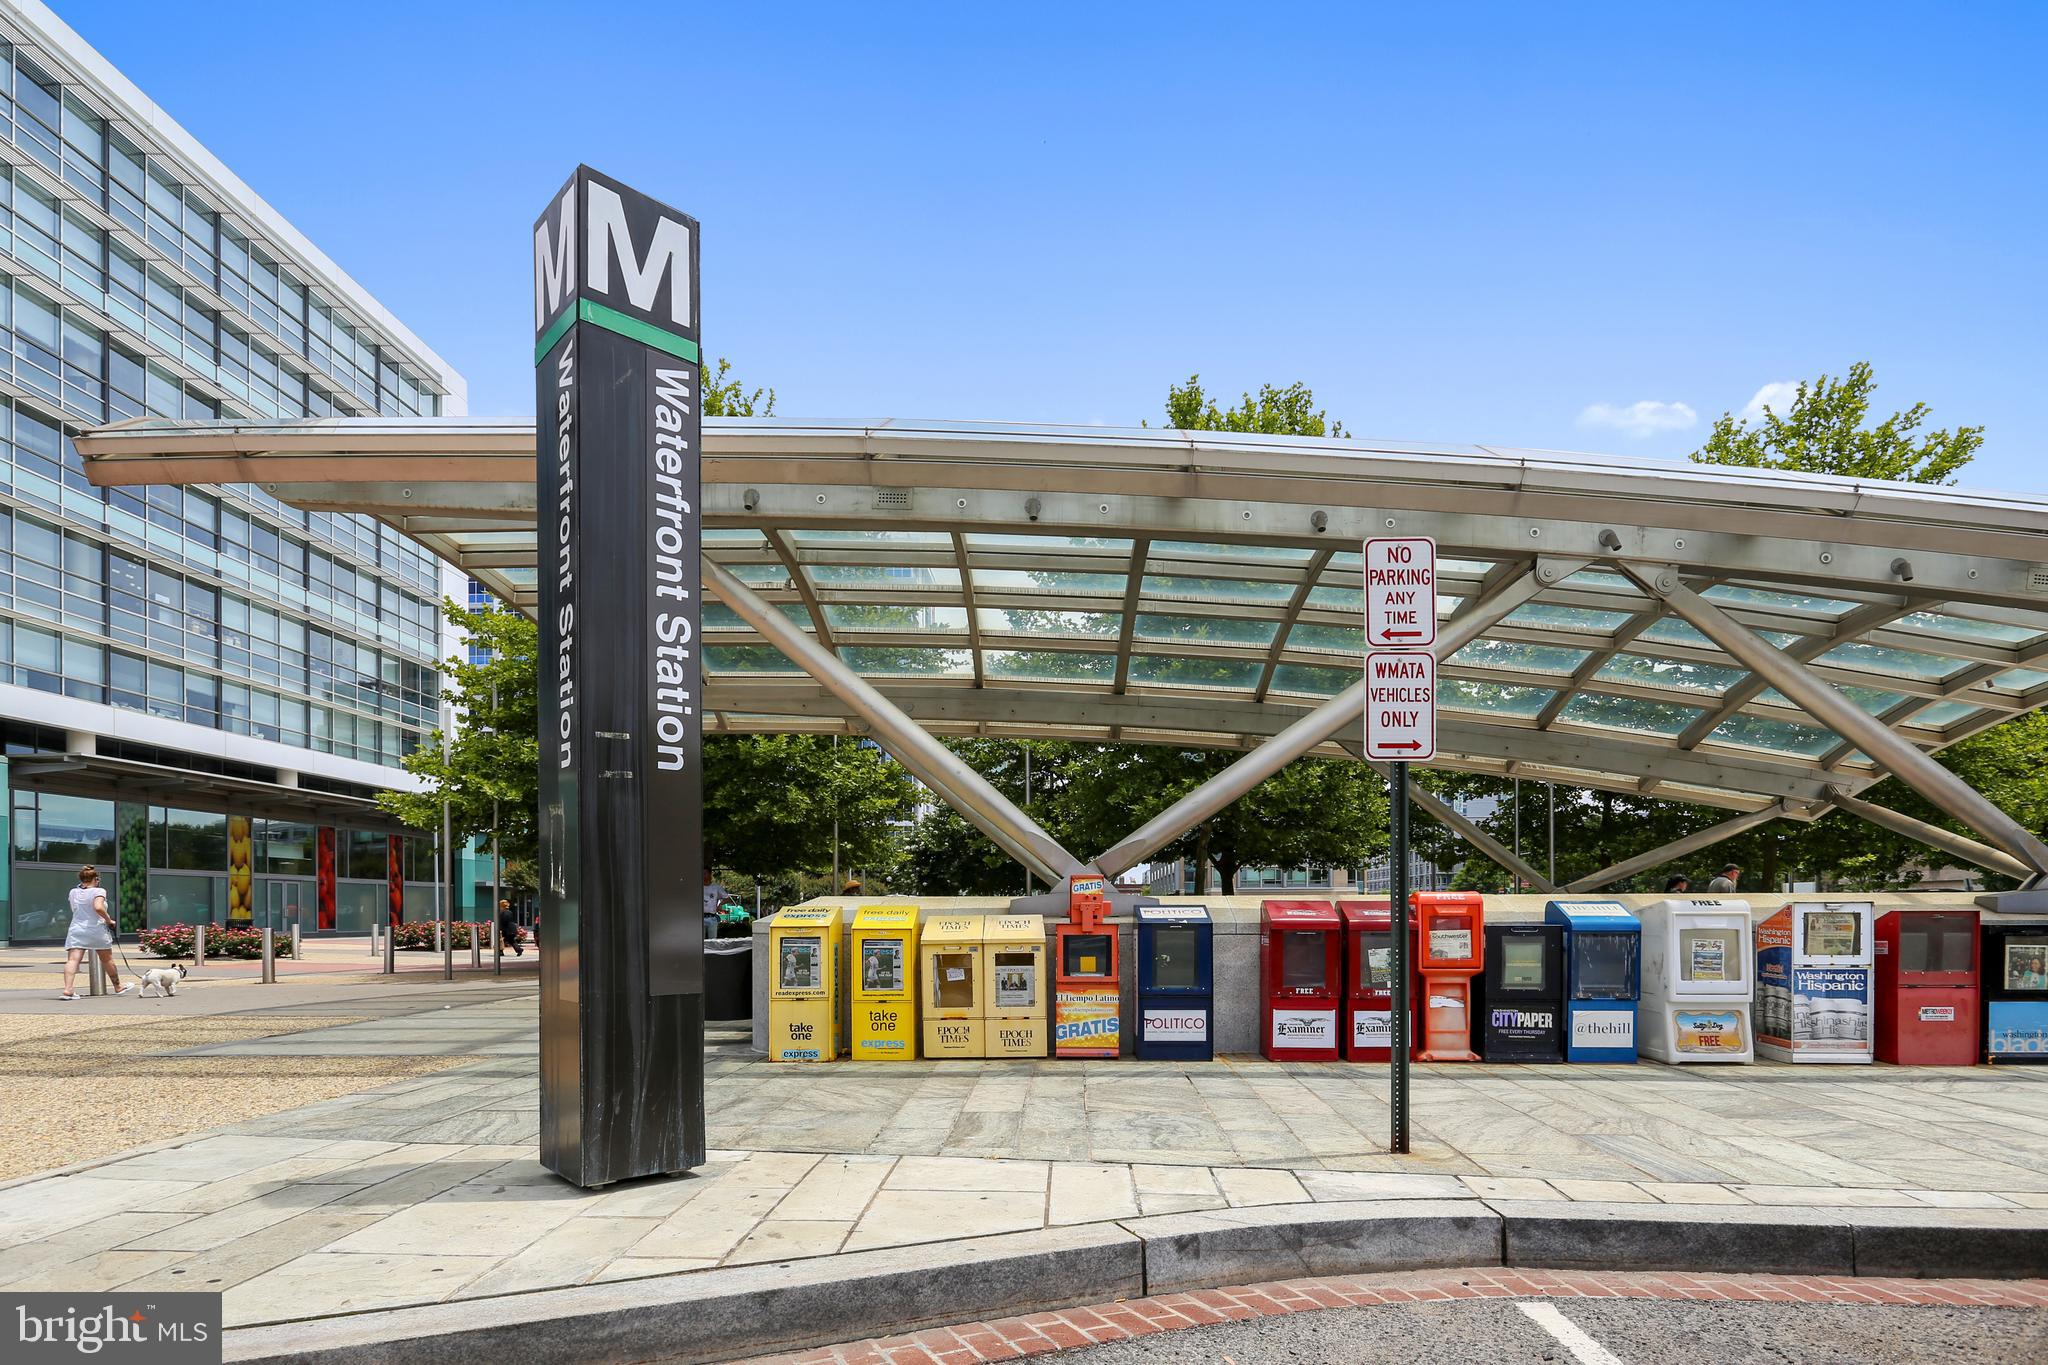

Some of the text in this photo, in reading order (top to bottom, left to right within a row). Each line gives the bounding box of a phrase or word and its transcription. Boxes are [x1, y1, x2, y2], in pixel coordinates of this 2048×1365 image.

[535, 184, 575, 332] M
[588, 179, 690, 328] M
[558, 338, 574, 769] Waterfront Station
[1387, 547, 1412, 564] NO
[655, 368, 692, 771] Waterfront Station
[1369, 569, 1431, 586] PARKING
[1385, 591, 1416, 605] ANY
[1384, 611, 1417, 624] TIME
[1375, 662, 1425, 679] WMATA
[1370, 687, 1431, 703] VEHICLES
[1381, 711, 1419, 728] ONLY
[1073, 881, 1102, 892] GRATIS
[1759, 928, 1791, 937] Washington
[1758, 935, 1791, 945] Hispanic
[1796, 971, 1864, 981] Washington
[1798, 980, 1864, 992] Hispanic
[1065, 994, 1094, 1003] Tiempo
[1095, 994, 1120, 1002] Latino
[869, 1009, 898, 1021] take
[789, 1022, 813, 1032] take
[871, 1021, 896, 1031] one
[1056, 1017, 1119, 1040] GRATIS
[1144, 1017, 1205, 1029] POLITICO
[1277, 1022, 1326, 1036] Examiner
[1575, 1022, 1631, 1036] @thehill
[791, 1032, 812, 1041] one
[937, 1026, 970, 1035] EPOCH
[999, 1030, 1033, 1039] EPOCH
[2002, 1029, 2048, 1040] washington
[861, 1039, 905, 1049] express
[939, 1035, 970, 1044] TIMES
[1001, 1038, 1032, 1047] TIMES
[1698, 1035, 1721, 1047] FREE
[783, 1050, 819, 1059] express
